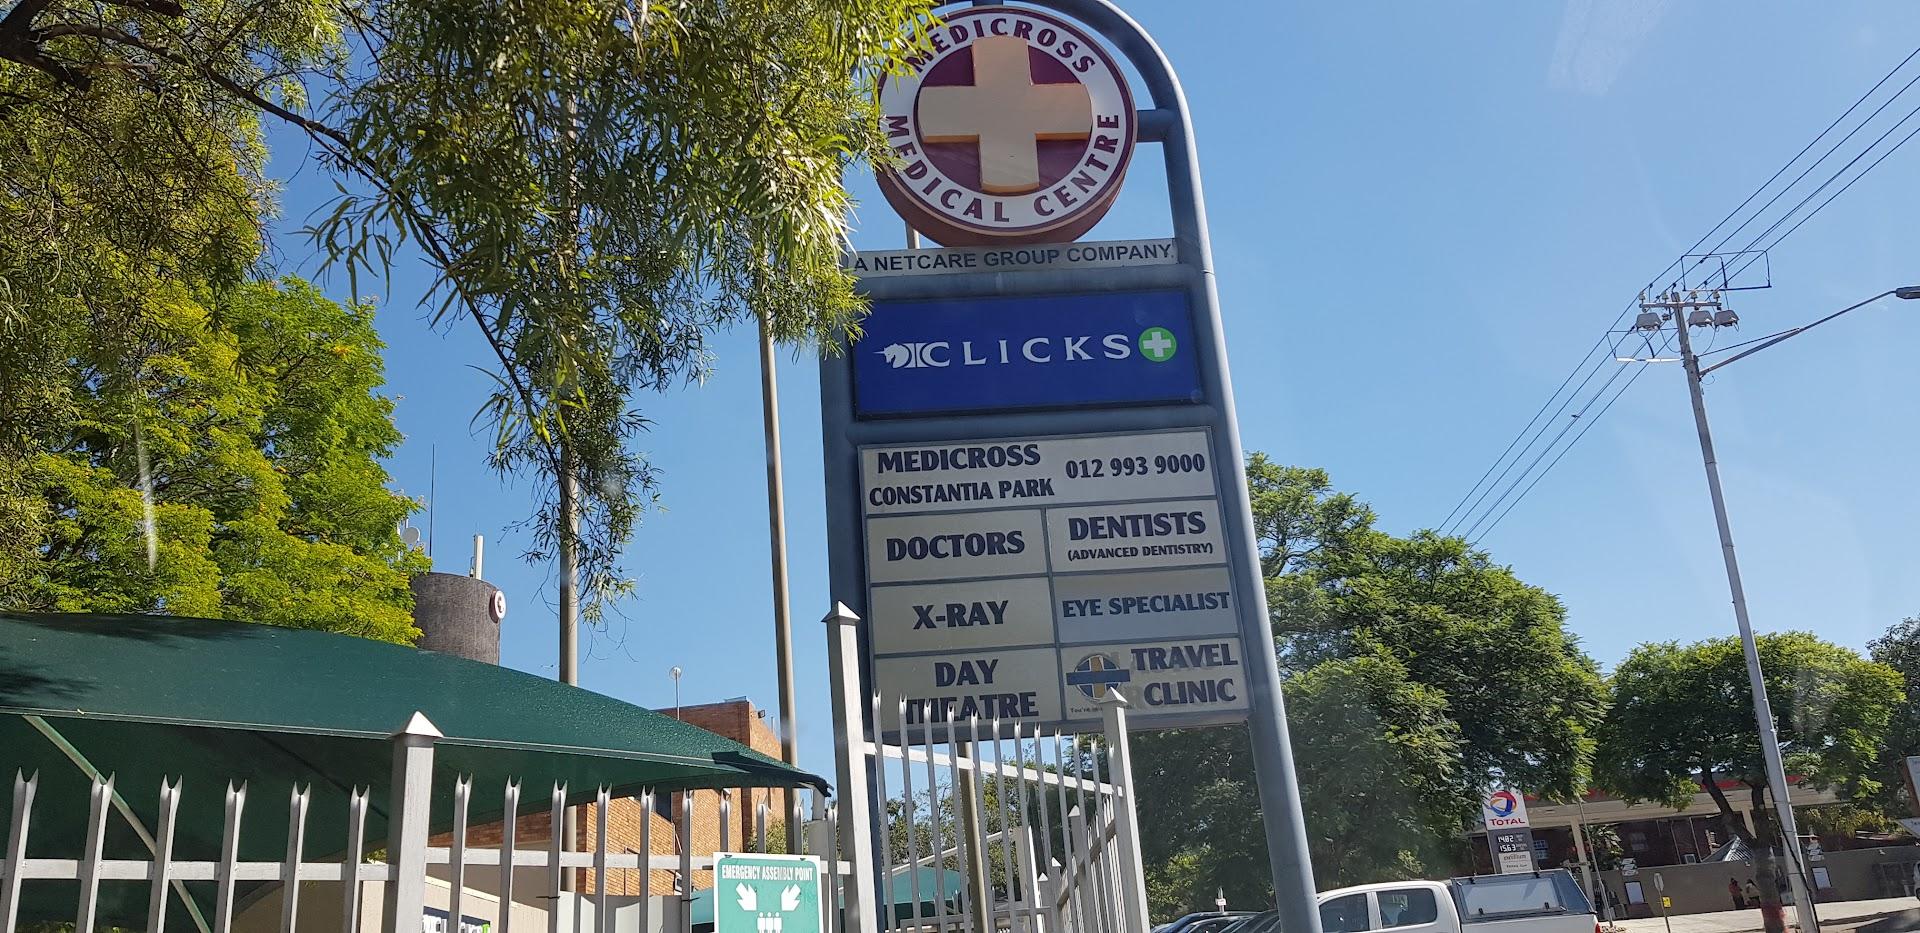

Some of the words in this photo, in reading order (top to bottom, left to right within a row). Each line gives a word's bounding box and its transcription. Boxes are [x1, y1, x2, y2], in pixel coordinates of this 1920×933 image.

[905, 18, 1095, 73] MEDICROSS
[886, 115, 1010, 222] MEDICAL
[1034, 114, 1119, 216] CENTRE
[854, 258, 869, 272] A
[874, 253, 977, 271] NETCARE
[984, 249, 1060, 267] GROUP
[920, 333, 1132, 368] CLICKS
[877, 443, 1041, 474] MEDICROSS
[1066, 459, 1104, 479] 012
[1111, 456, 1148, 477] 993
[1155, 453, 1206, 473] 9000
[869, 483, 994, 507] CONSTANTIA
[999, 478, 1055, 498] PARK
[1068, 511, 1207, 541] DENTISTS
[886, 530, 1025, 562] DOCTORS
[1067, 546, 1140, 562] (ADVANCED
[1142, 543, 1213, 557] DENTISTRY)
[913, 600, 1009, 630] X-RAY
[1062, 599, 1103, 619] EYE
[1109, 591, 1230, 615] SPECIALIST
[1131, 643, 1238, 671] TRAVEL
[934, 658, 999, 688] DAY
[1143, 678, 1237, 706] CLINIC
[904, 691, 1039, 724] THEATRE
[1490, 818, 1526, 826] TOTAL
[721, 864, 760, 880] EMERGENCY
[761, 866, 794, 880] ASSEMBLY
[794, 867, 813, 881] POINT
